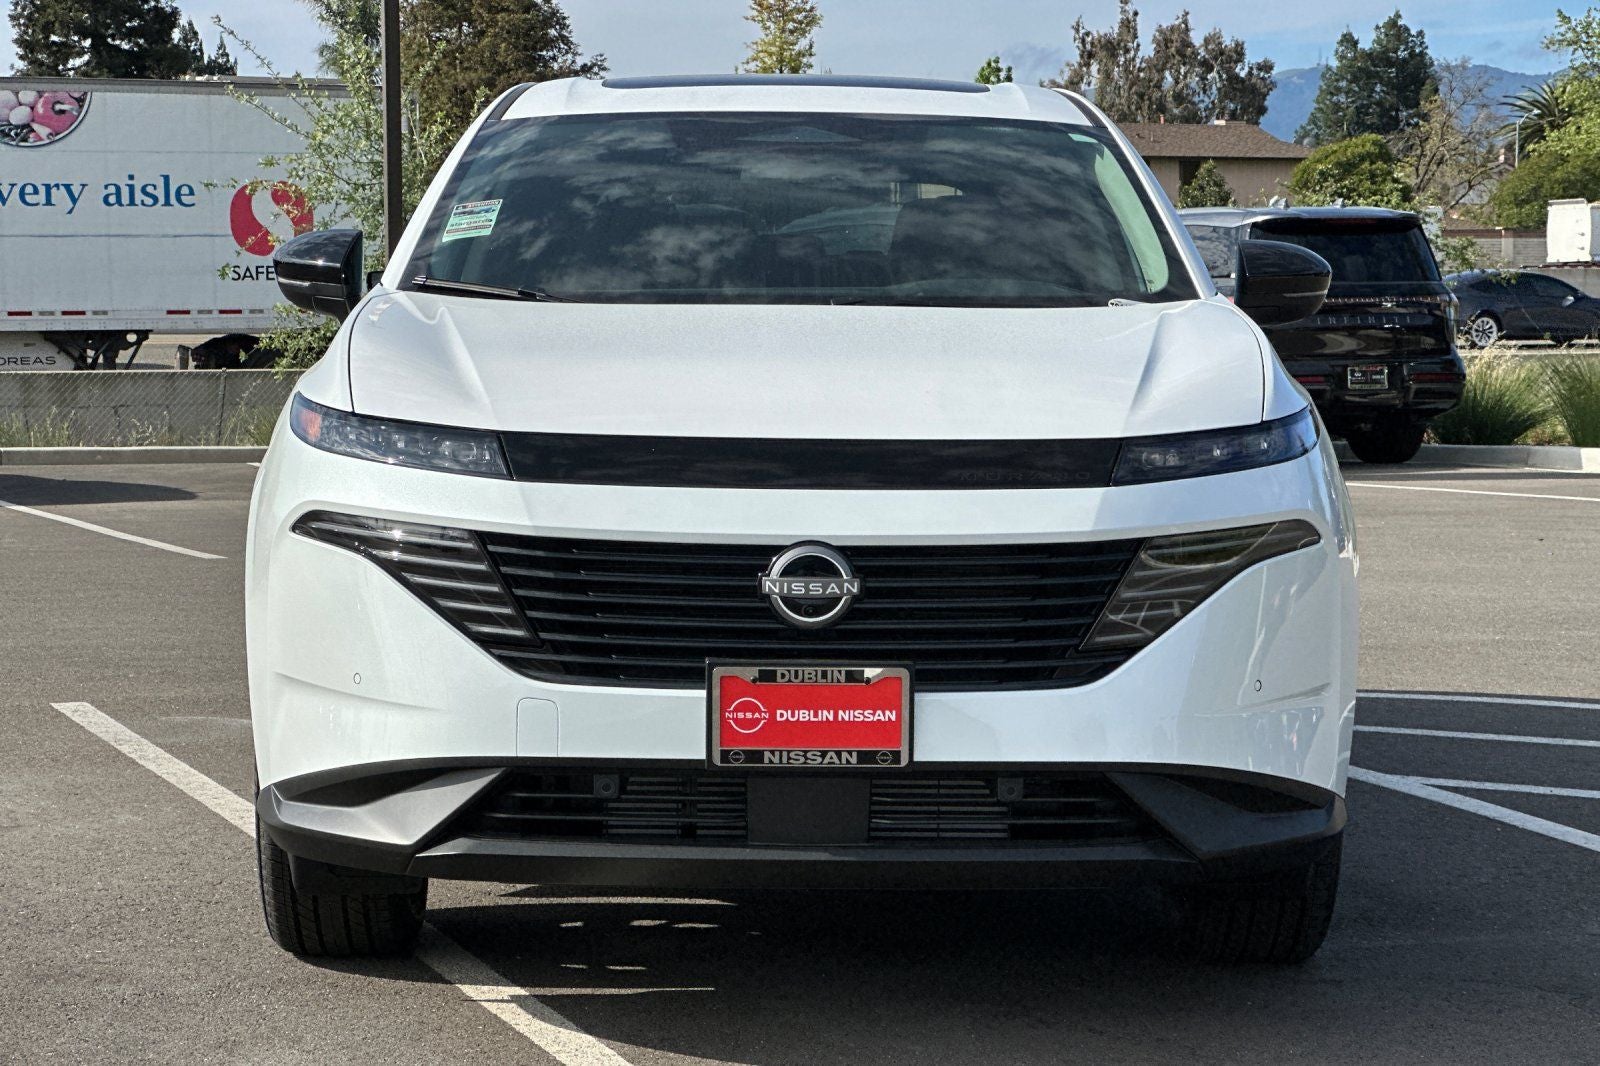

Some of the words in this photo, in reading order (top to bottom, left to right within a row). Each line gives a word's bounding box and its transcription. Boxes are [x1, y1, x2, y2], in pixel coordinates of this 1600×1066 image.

[0, 182, 89, 215] very
[102, 174, 196, 208] aisle
[231, 265, 275, 281] SAFE
[1317, 315, 1410, 325] INFINITI
[765, 581, 858, 594] NISSAN
[776, 669, 845, 683] DUBLIN
[725, 711, 769, 719] NISSAN
[776, 710, 834, 722] DUBLIN
[838, 710, 896, 722] NISSAN
[763, 751, 858, 765] NISSAN
